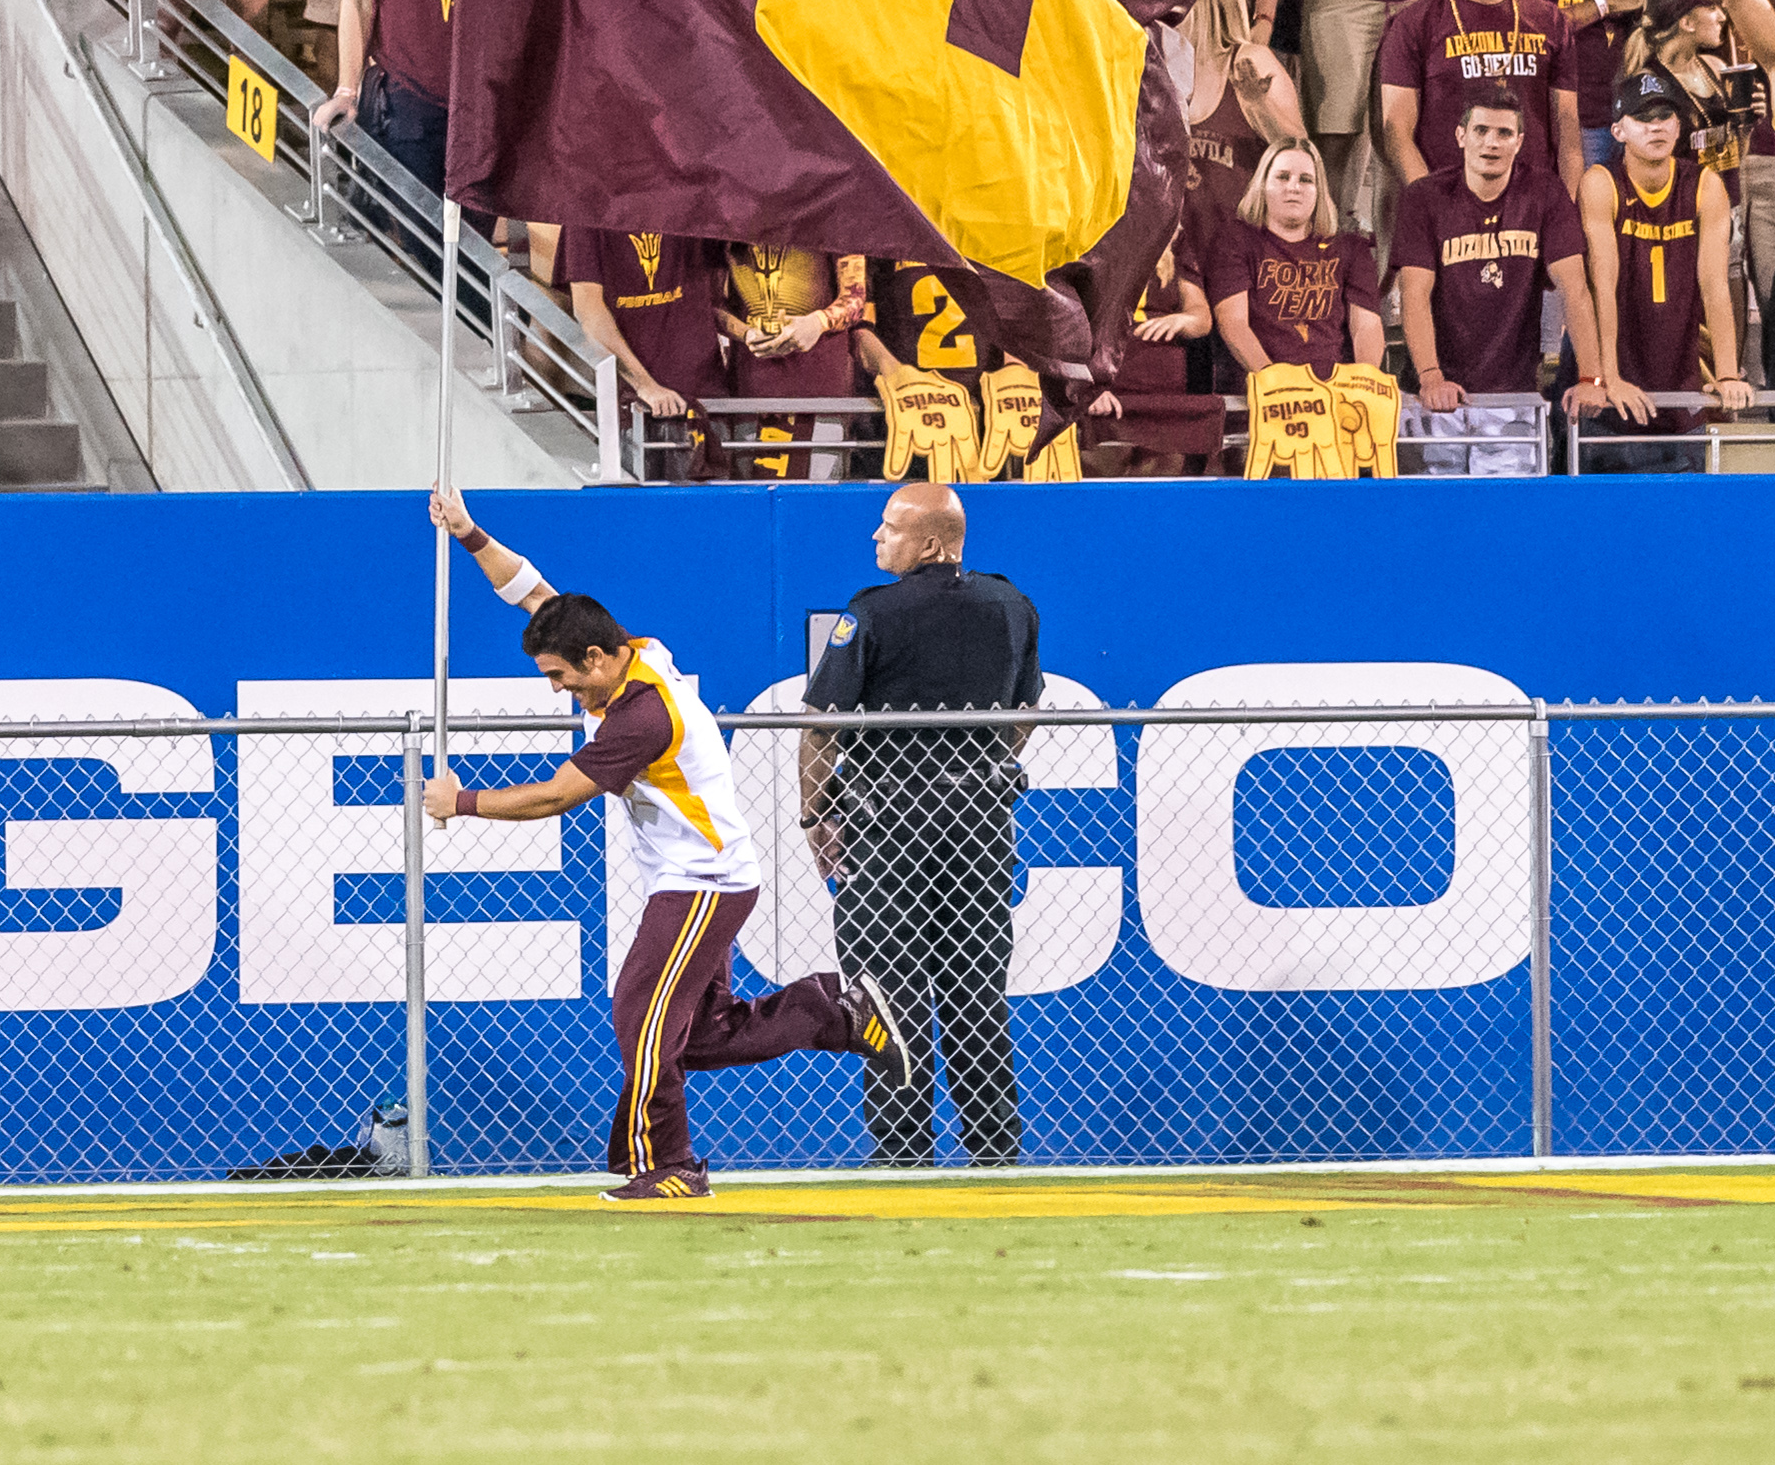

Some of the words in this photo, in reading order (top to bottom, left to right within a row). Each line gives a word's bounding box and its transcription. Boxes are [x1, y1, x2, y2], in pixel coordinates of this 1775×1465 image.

[1445, 32, 1504, 59] ARIZONA
[1506, 32, 1547, 55] STATE
[1460, 54, 1482, 79] GO
[1483, 52, 1537, 77] DEVILS
[239, 77, 264, 143] 18
[1189, 136, 1234, 170] EVILS
[1662, 218, 1696, 241] STATE
[1443, 231, 1499, 268] ARIZONA
[1498, 229, 1539, 259] STATE
[1257, 257, 1341, 290] FORK
[1649, 245, 1667, 303] 1
[1268, 286, 1335, 322] 'EM
[910, 274, 978, 370] 2
[898, 391, 961, 413] Devils!
[996, 395, 1044, 413] evils!
[1261, 398, 1326, 425] Devils!
[920, 412, 946, 431] Go
[1283, 421, 1310, 439] Go
